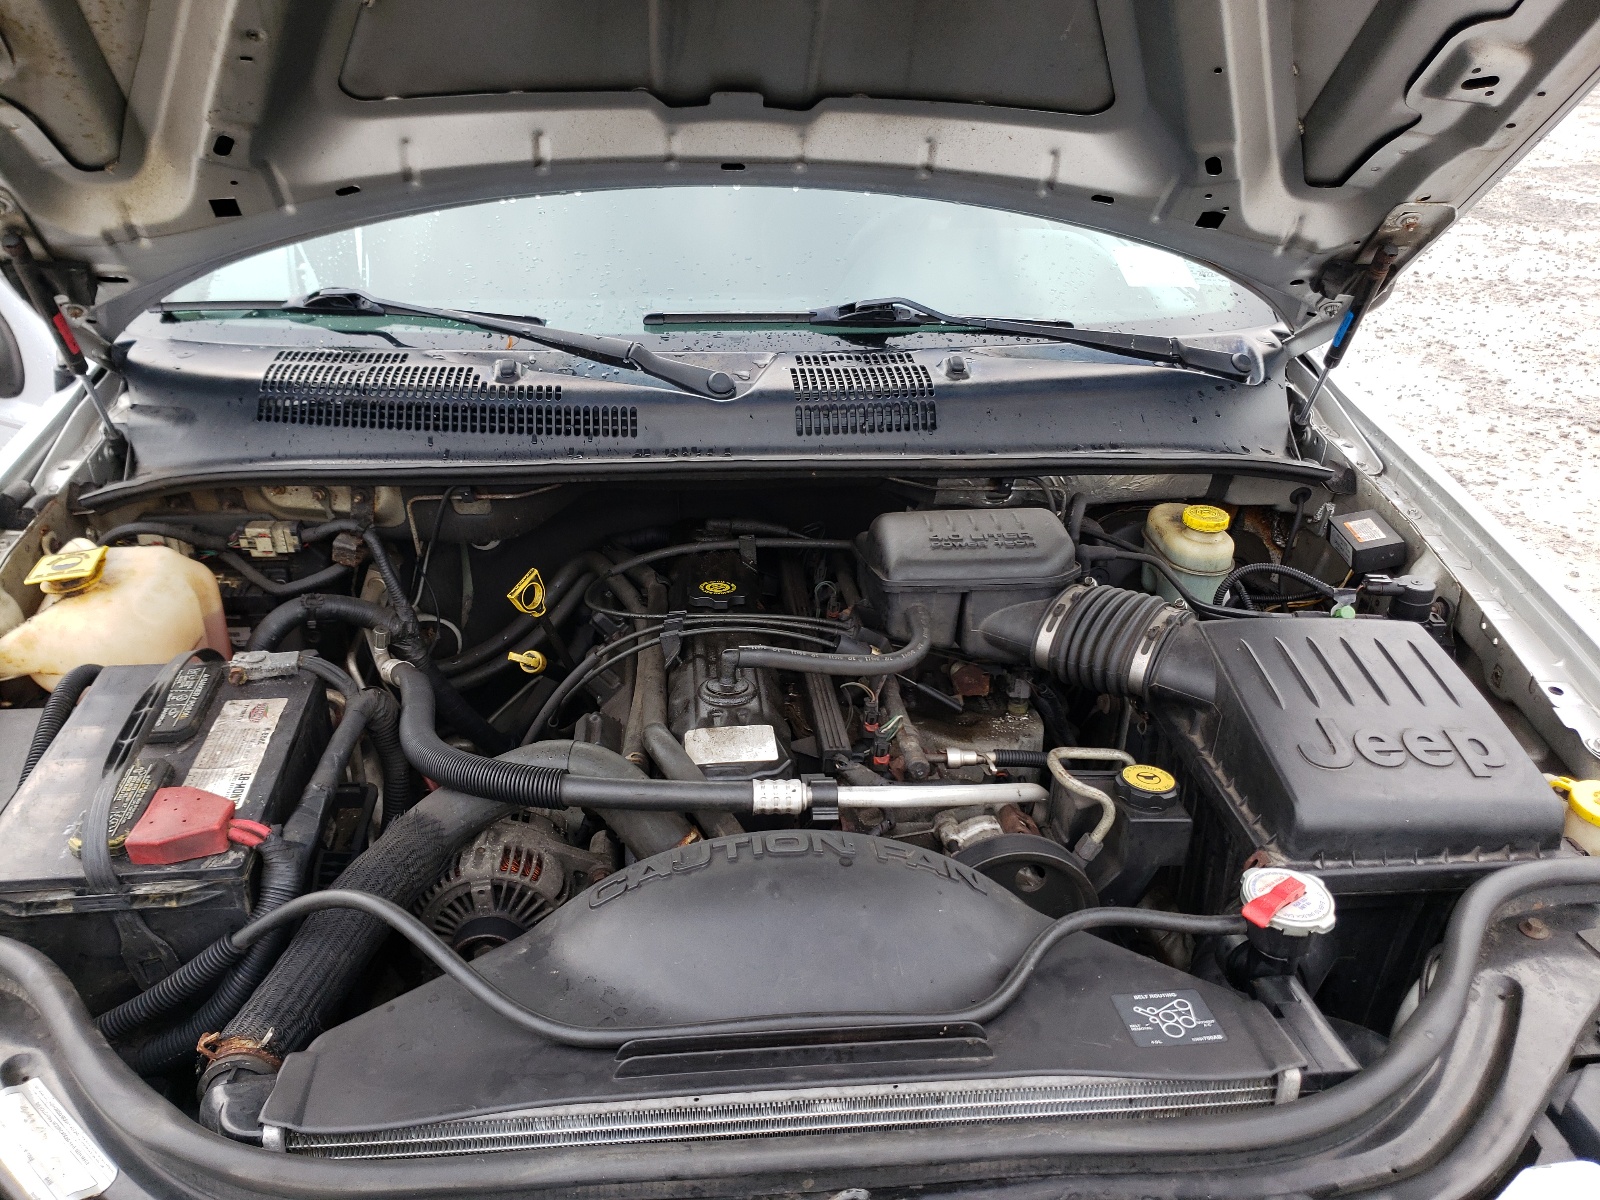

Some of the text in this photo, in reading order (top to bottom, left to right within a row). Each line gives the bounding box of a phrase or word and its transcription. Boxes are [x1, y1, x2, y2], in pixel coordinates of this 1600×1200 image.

[929, 532, 1033, 542] 4.0 LITER
[930, 540, 988, 550] POWER
[1297, 717, 1507, 778] Jeep
[588, 831, 989, 909] CAUTION FAN
[1149, 992, 1178, 1000] ROUTING
